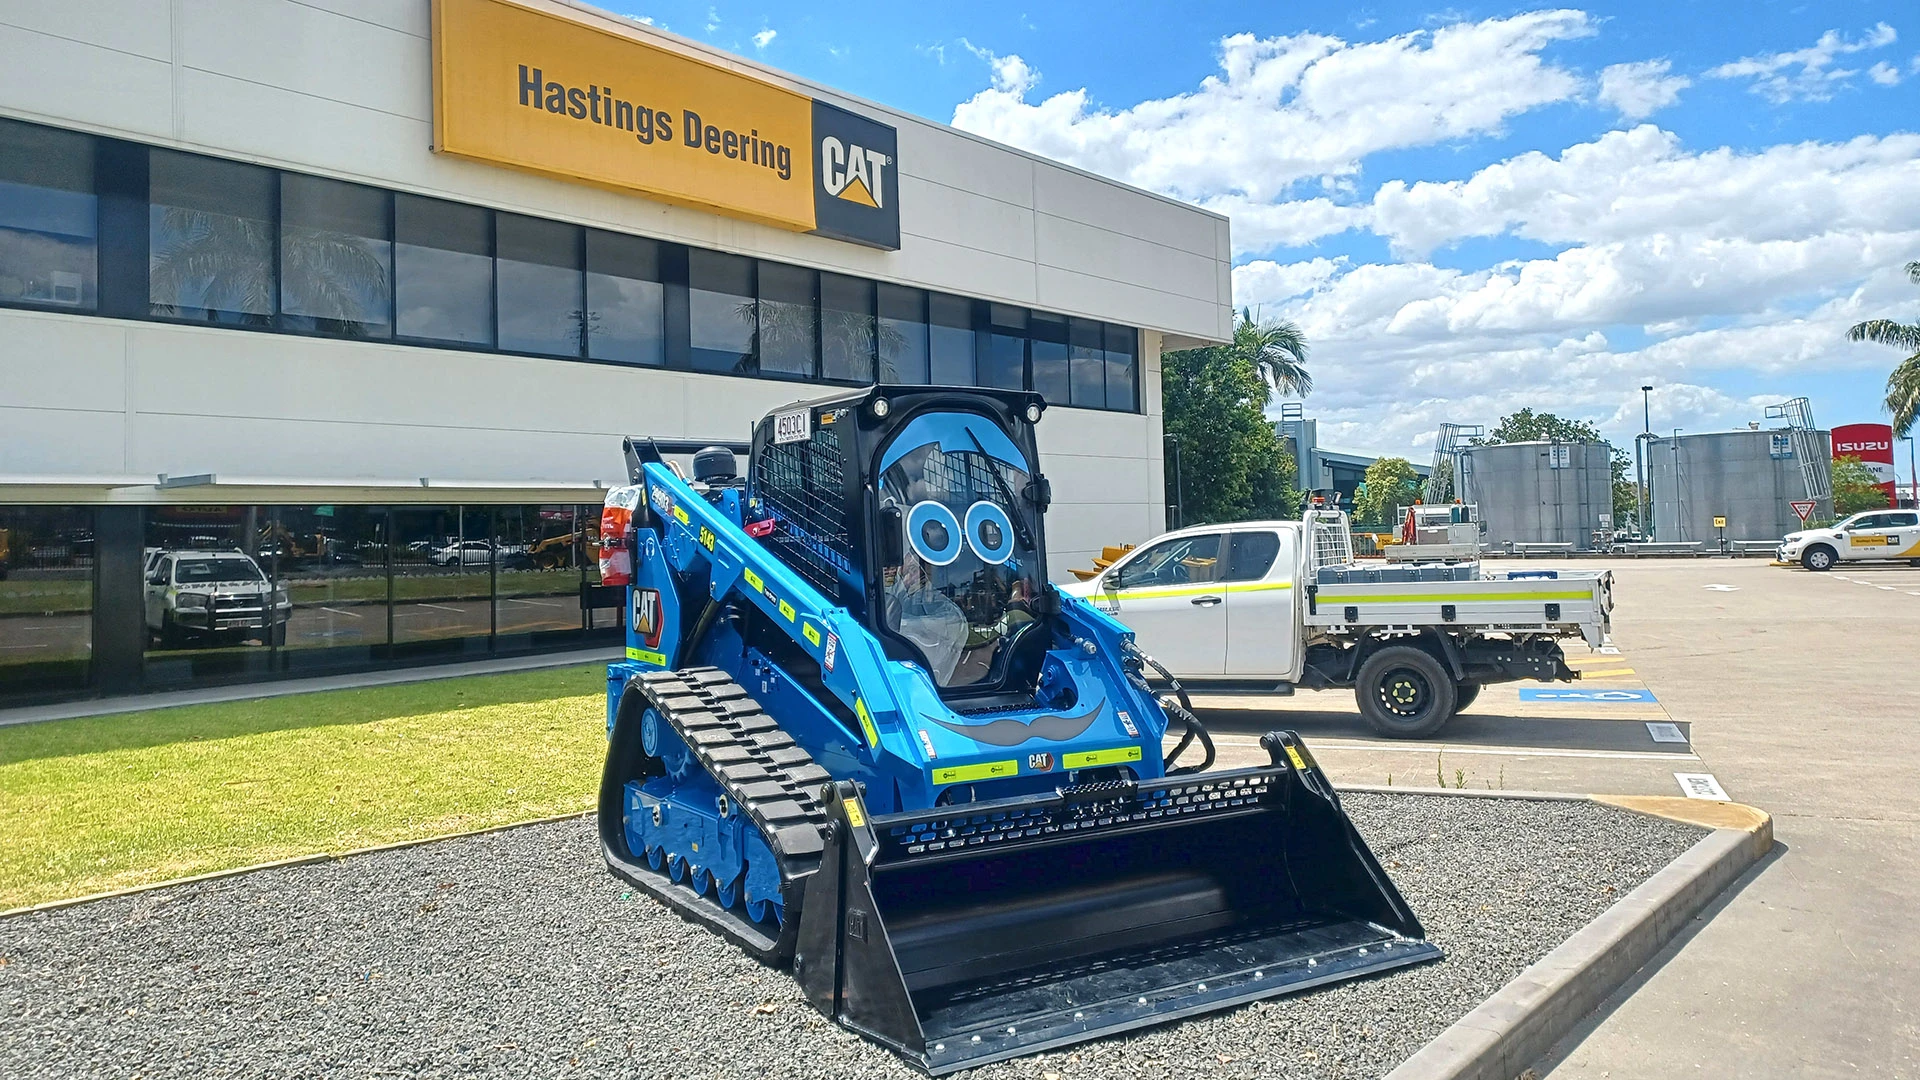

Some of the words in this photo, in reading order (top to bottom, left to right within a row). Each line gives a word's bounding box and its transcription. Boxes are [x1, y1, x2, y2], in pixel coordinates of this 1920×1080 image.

[518, 64, 673, 145] Hastings
[683, 109, 791, 180] Deering
[822, 136, 886, 208] CAT
[1837, 441, 1889, 452] ISUZU
[632, 589, 657, 634] CAT
[1028, 753, 1048, 769] CAT
